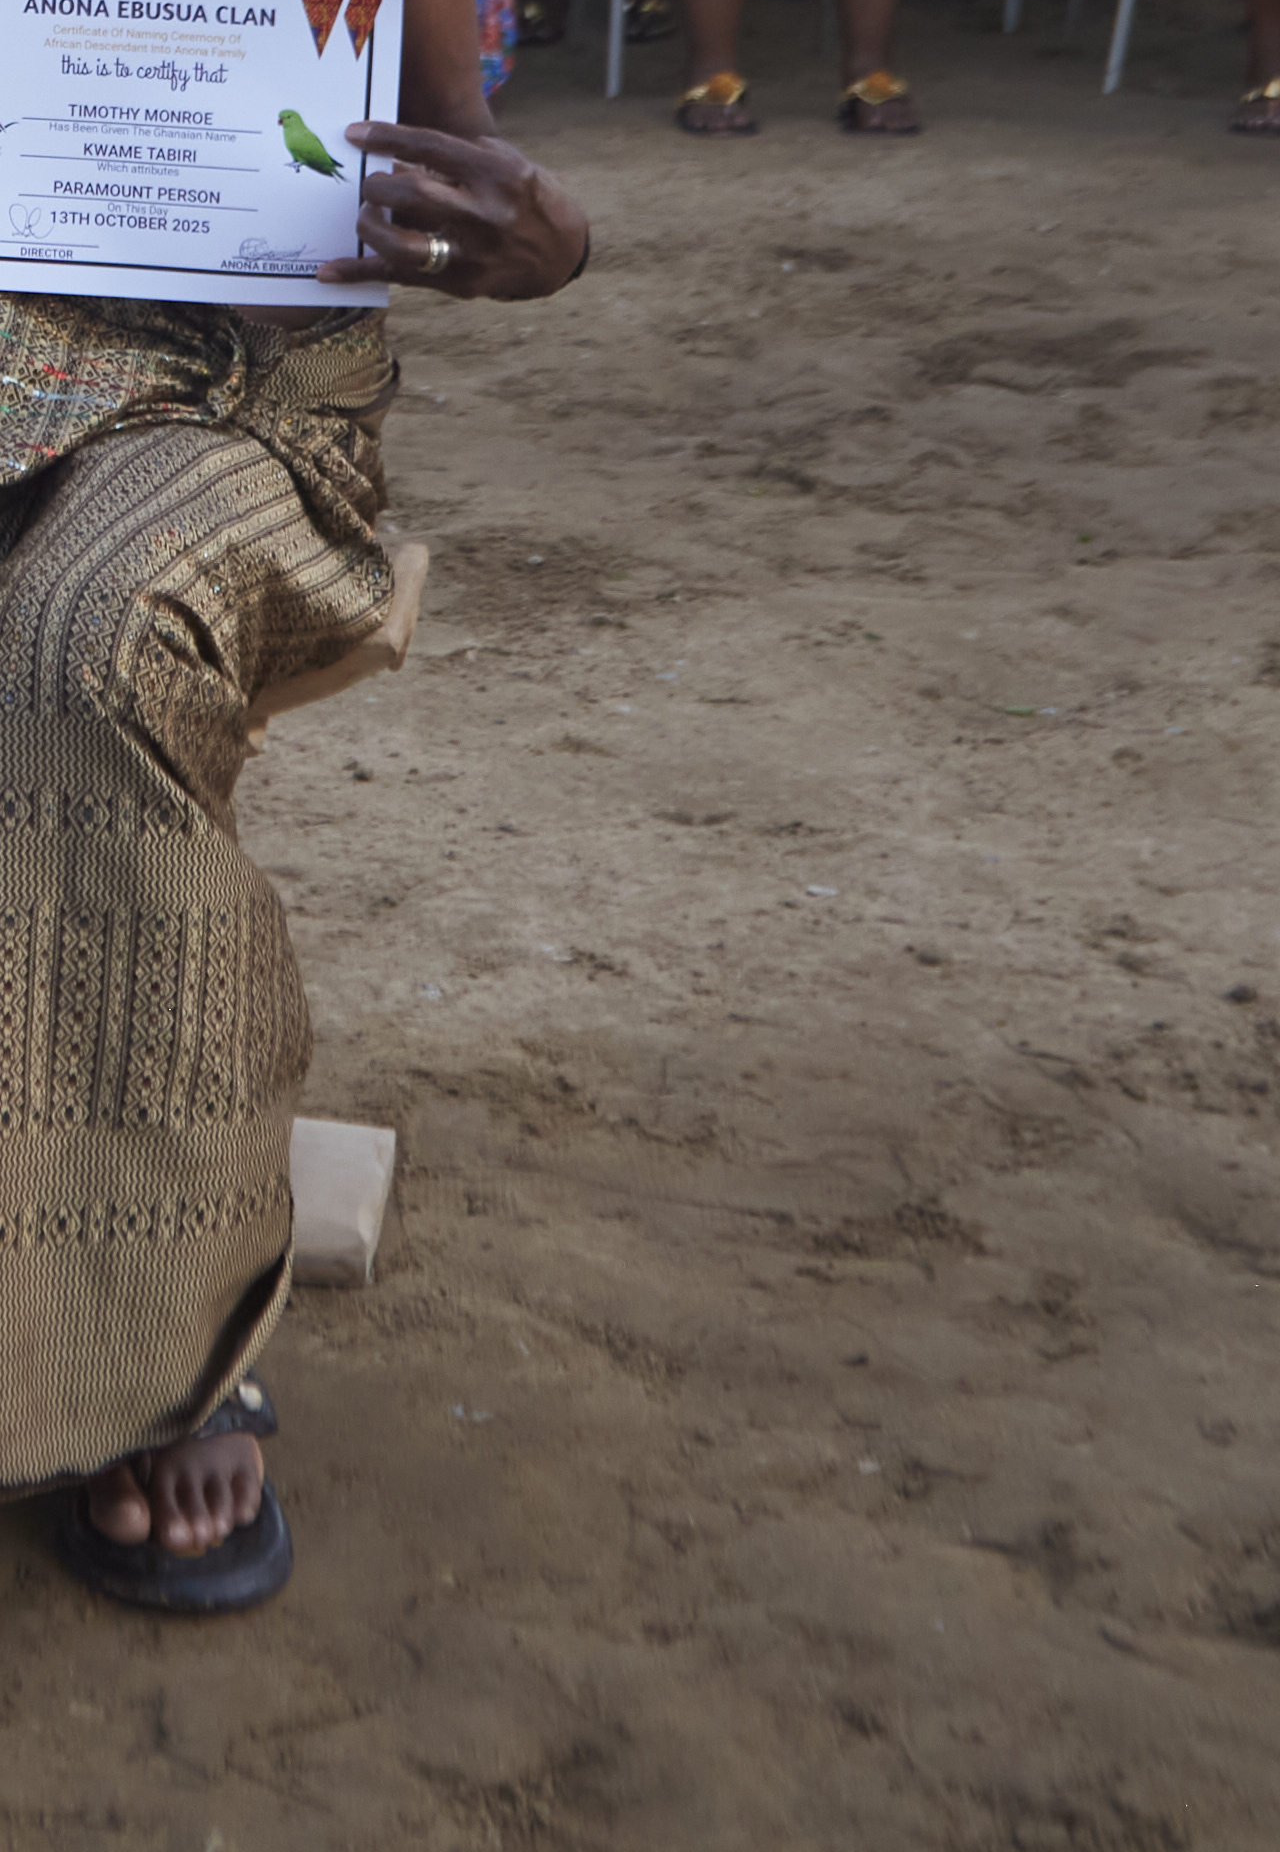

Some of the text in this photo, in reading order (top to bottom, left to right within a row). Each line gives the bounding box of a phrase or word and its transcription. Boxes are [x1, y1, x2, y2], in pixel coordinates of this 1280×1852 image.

[117, 1, 208, 23] EBUSUA
[215, 6, 276, 27] CLAN
[52, 25, 242, 46] Certificate Of Naming Ceremony Of
[44, 38, 82, 49] African
[84, 40, 148, 53] Descendant
[174, 45, 208, 57] Anona
[211, 47, 246, 60] Family
[60, 54, 229, 91] this is to certify that
[68, 104, 214, 126] TIMOTHY MONROE
[49, 121, 237, 143] Has Been Given The Ghanaian Name
[83, 143, 197, 163] KWAME TABIRI
[97, 162, 180, 177] Which attributes
[53, 180, 220, 204] PARAMOUNT PERSON
[107, 203, 169, 217] On This Day
[50, 211, 90, 226] 13TH
[94, 213, 168, 231] OCTOBER
[172, 219, 211, 234] 2025
[20, 247, 73, 259] DIRECTOR
[221, 259, 319, 273] ANONA EBUSUAPA
